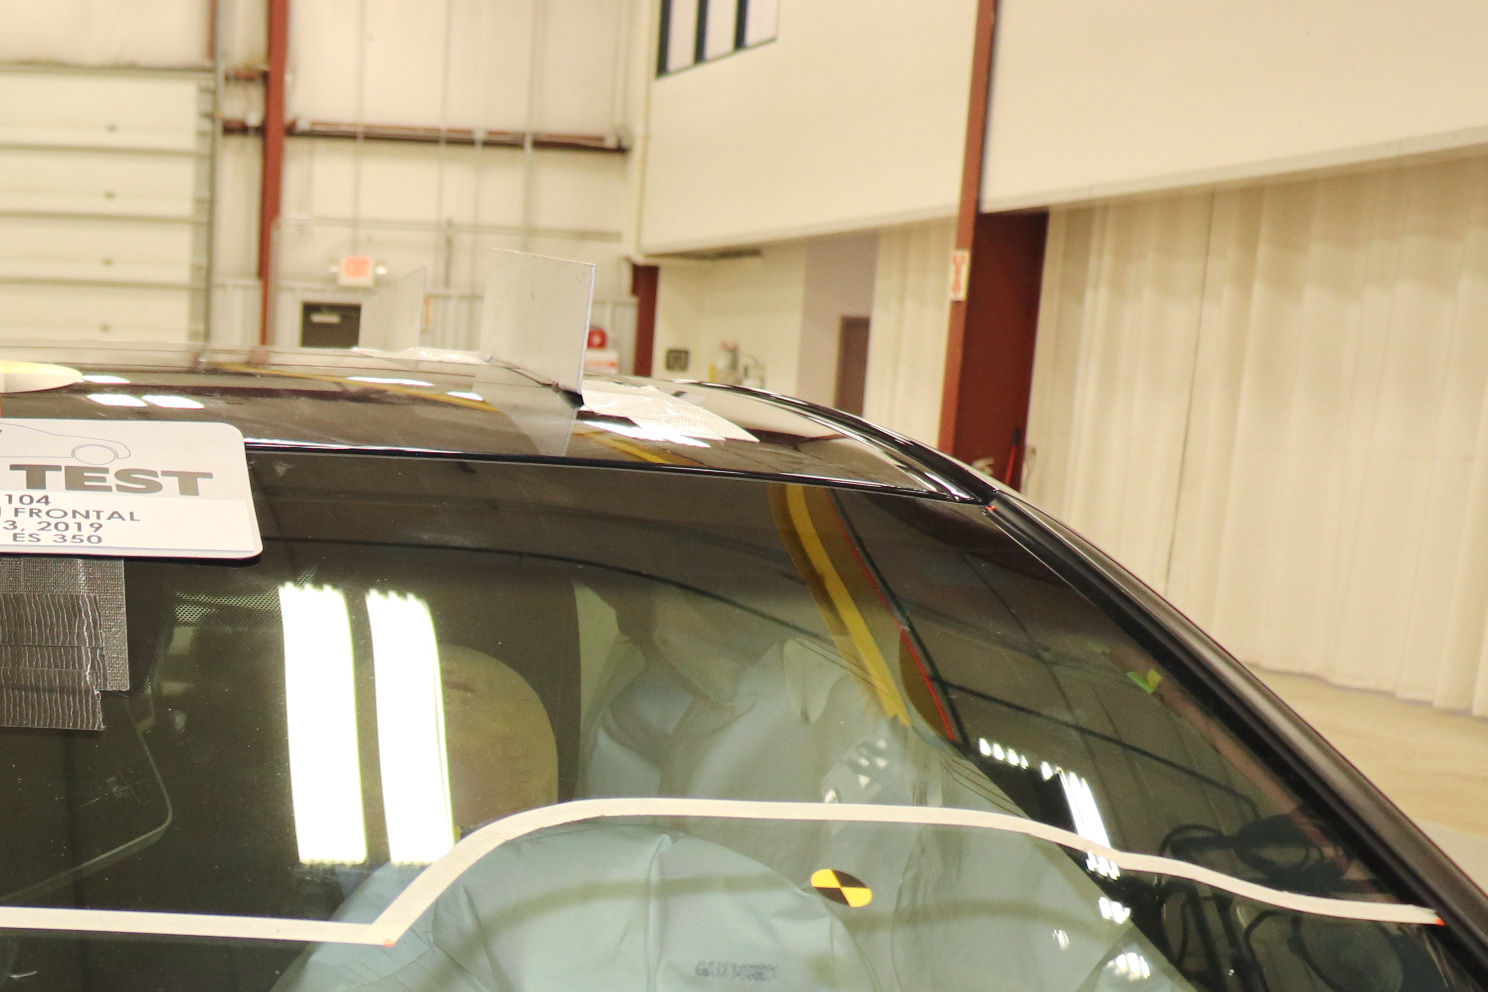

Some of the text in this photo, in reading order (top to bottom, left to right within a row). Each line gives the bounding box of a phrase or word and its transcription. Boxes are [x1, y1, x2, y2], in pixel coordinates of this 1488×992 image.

[9, 464, 213, 497] TEST
[13, 507, 141, 522] FRONTAL
[37, 521, 104, 533] 2019
[12, 532, 42, 543] ES
[52, 533, 104, 545] 350
